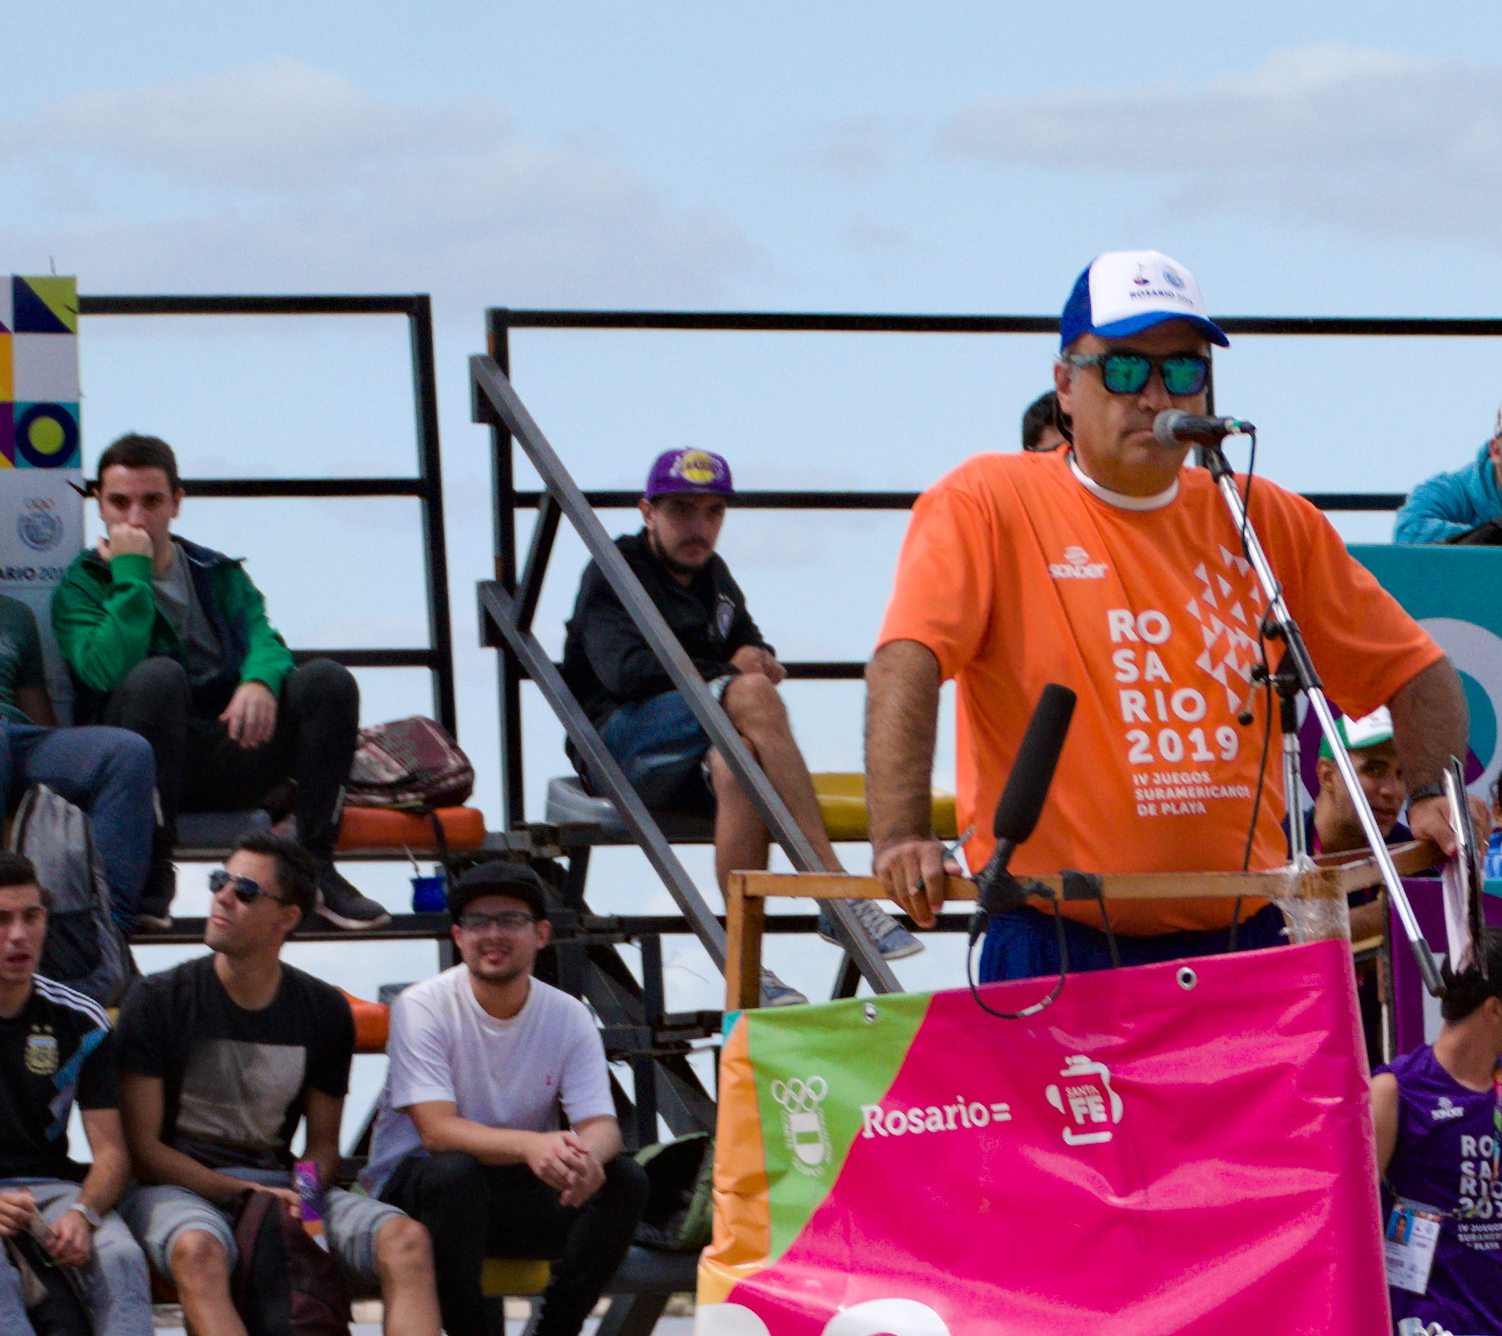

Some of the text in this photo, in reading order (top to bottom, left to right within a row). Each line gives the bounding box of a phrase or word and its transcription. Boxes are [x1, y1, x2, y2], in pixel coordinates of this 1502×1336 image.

[1106, 608, 1172, 645] RO
[1111, 648, 1172, 684] SA
[1118, 687, 1207, 724] RIO
[1124, 725, 1239, 765] 2019
[1152, 771, 1211, 786] JUEGOS
[1136, 801, 1207, 817] DE PLAYA
[1064, 1084, 1101, 1099] SANTA
[859, 1094, 1012, 1140] Rosario=
[1068, 1096, 1107, 1125] FE
[1459, 1134, 1495, 1159] RO
[1459, 1160, 1494, 1182] SA
